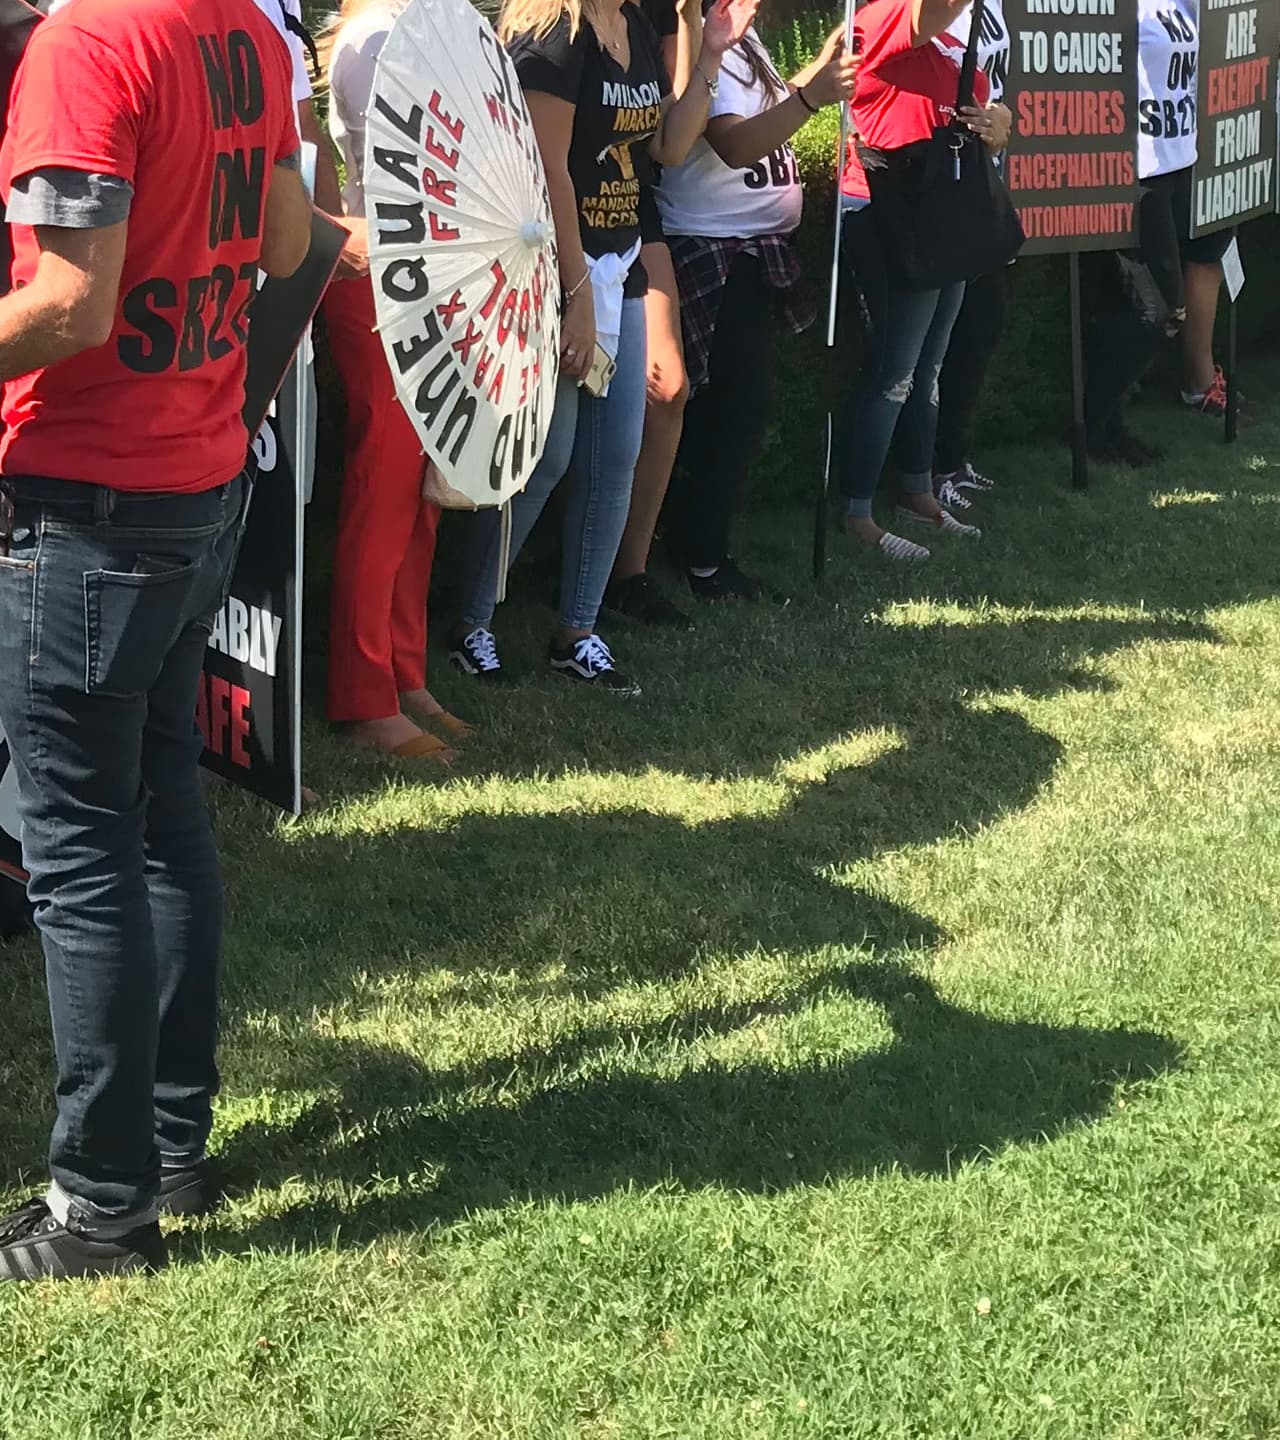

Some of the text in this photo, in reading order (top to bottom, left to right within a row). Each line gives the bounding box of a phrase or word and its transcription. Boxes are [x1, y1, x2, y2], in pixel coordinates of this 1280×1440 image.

[1156, 8, 1194, 43] NO
[1225, 8, 1257, 60] ARE
[197, 29, 265, 130] NO
[1020, 31, 1123, 75] TO CAUSE
[1167, 51, 1196, 91] ON
[1207, 56, 1269, 116] EXEMPT
[1017, 90, 1126, 138] SEIZURES
[1215, 110, 1261, 167] FROM
[422, 89, 465, 245] FREE
[1010, 151, 1134, 191] ENCEPHALITIS
[1196, 157, 1273, 227] LIABILITY
[209, 145, 267, 251] ON
[1017, 202, 1134, 240] UTOIMMUNITY
[195, 671, 251, 769] AFE
